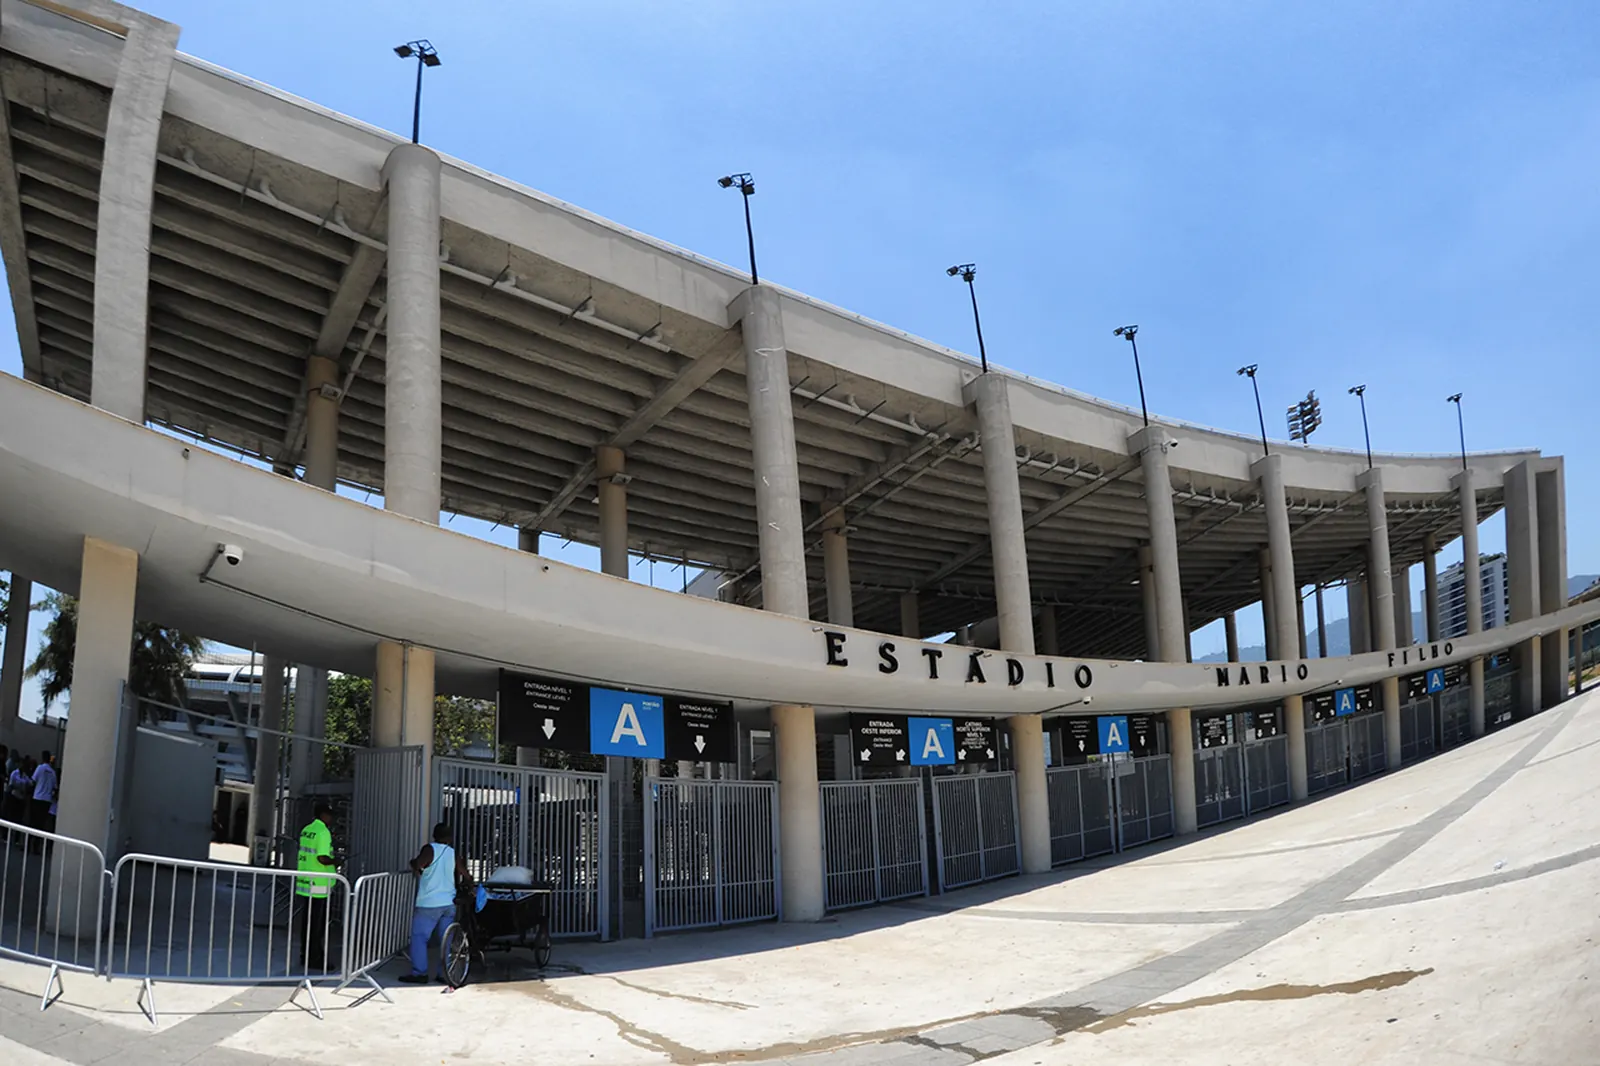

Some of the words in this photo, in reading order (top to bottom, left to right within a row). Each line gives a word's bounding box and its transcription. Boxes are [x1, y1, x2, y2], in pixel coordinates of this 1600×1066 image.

[824, 632, 1093, 689] ESTÁDIO
[1216, 664, 1308, 687] MARIO
[1387, 642, 1453, 668] FILHO
[524, 681, 551, 691] ENTRADA
[1431, 673, 1440, 689] A
[1340, 693, 1351, 712] A
[610, 703, 647, 746] A
[861, 727, 878, 735] OESTE
[869, 720, 895, 728] ENTRADA
[922, 728, 946, 759] A
[1107, 722, 1122, 747] A
